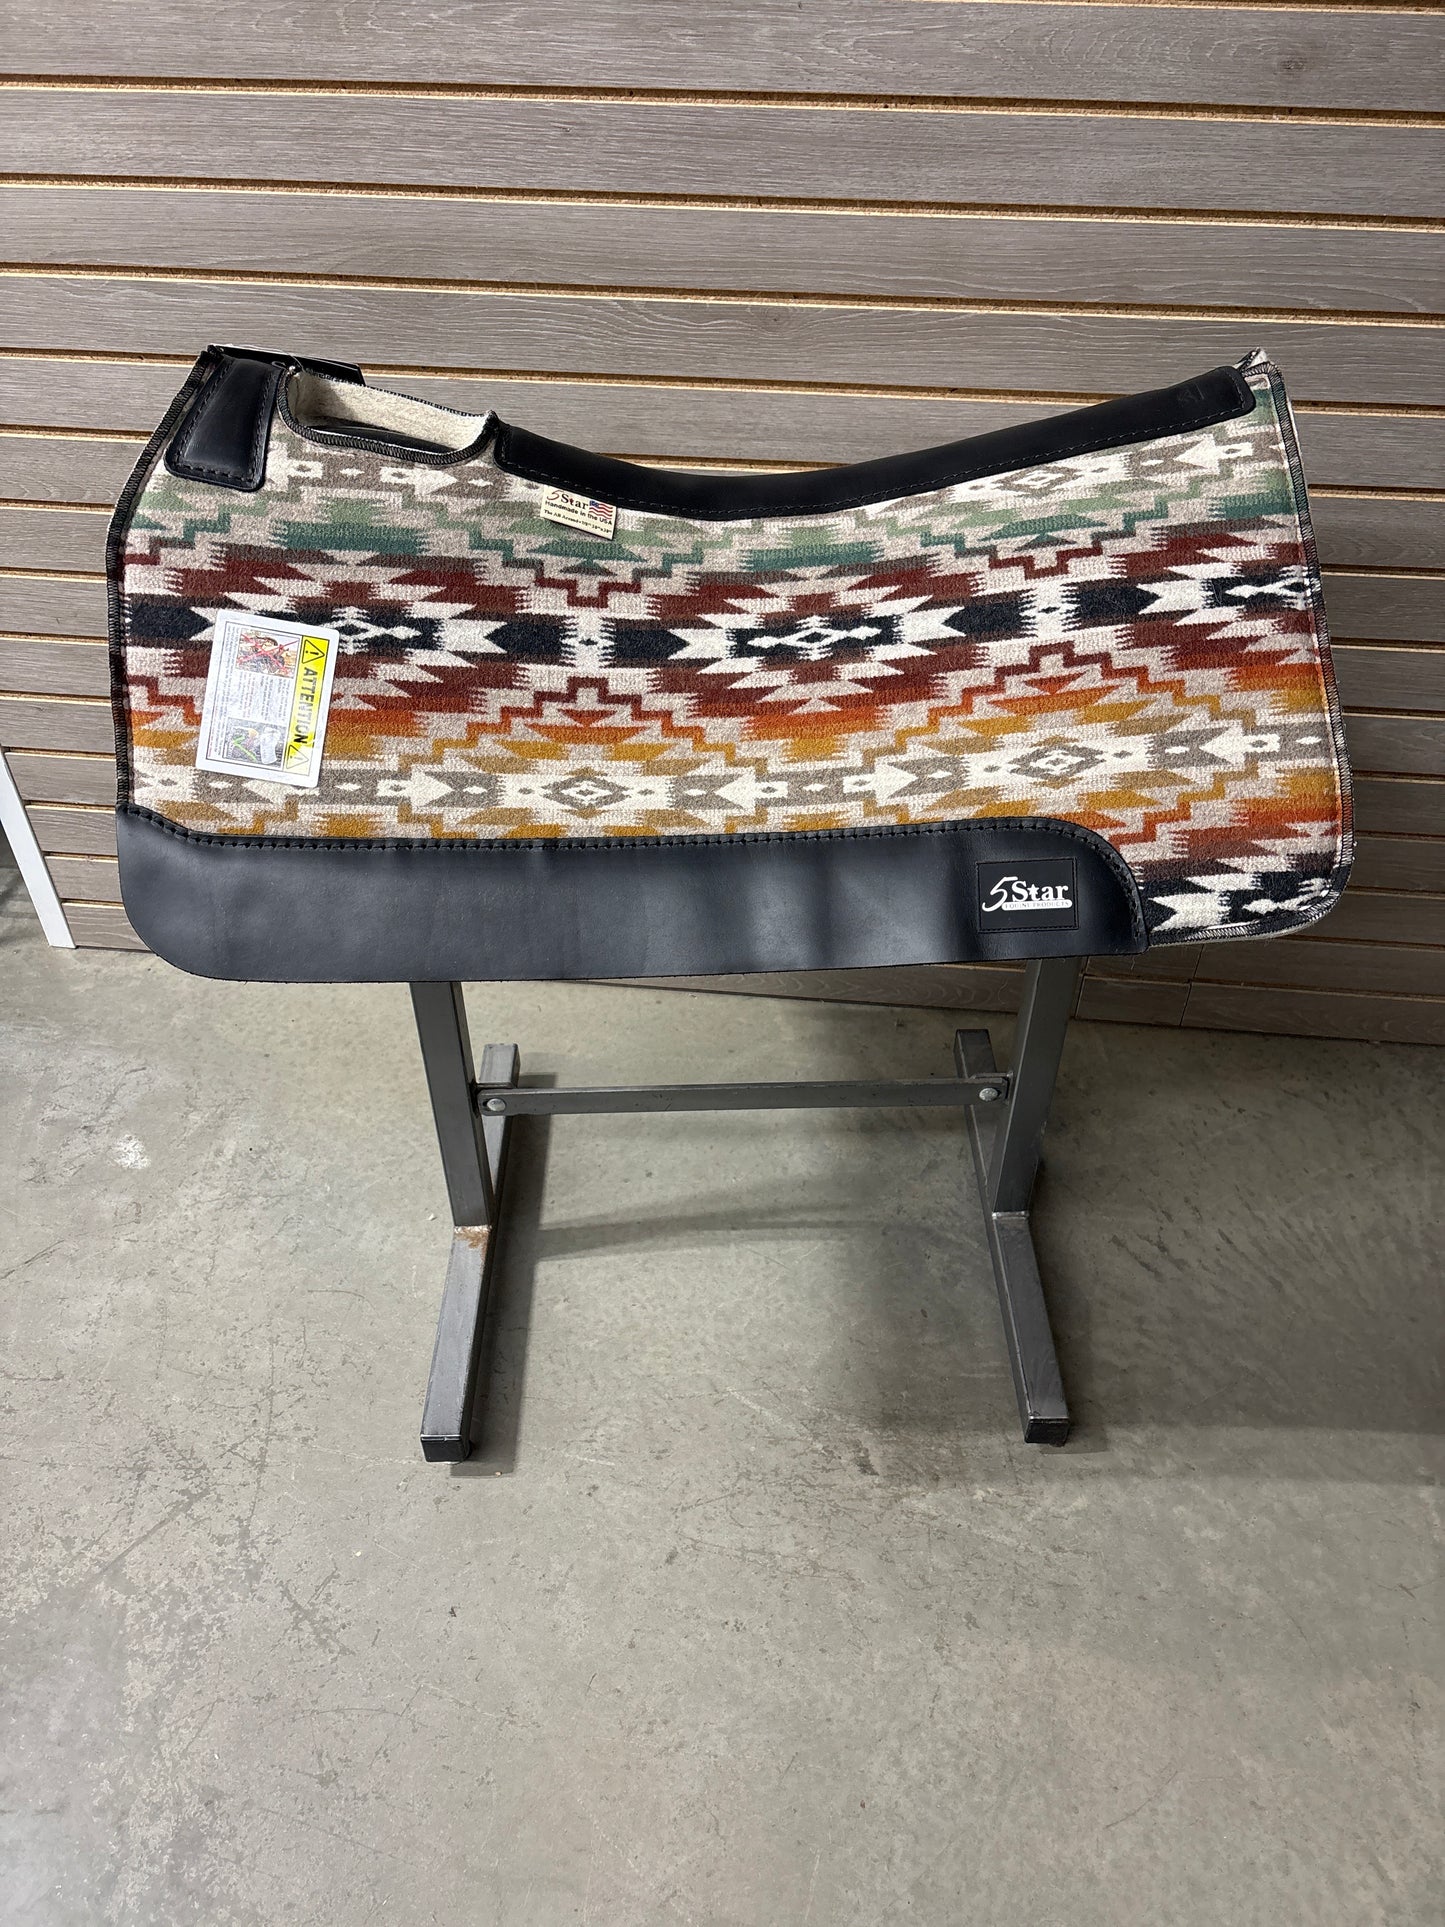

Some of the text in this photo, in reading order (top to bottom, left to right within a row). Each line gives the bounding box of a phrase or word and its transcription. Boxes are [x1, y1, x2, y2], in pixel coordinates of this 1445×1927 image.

[545, 501, 578, 514] Handmade
[600, 517, 613, 525] USA
[293, 667, 318, 744] ATTENTION
